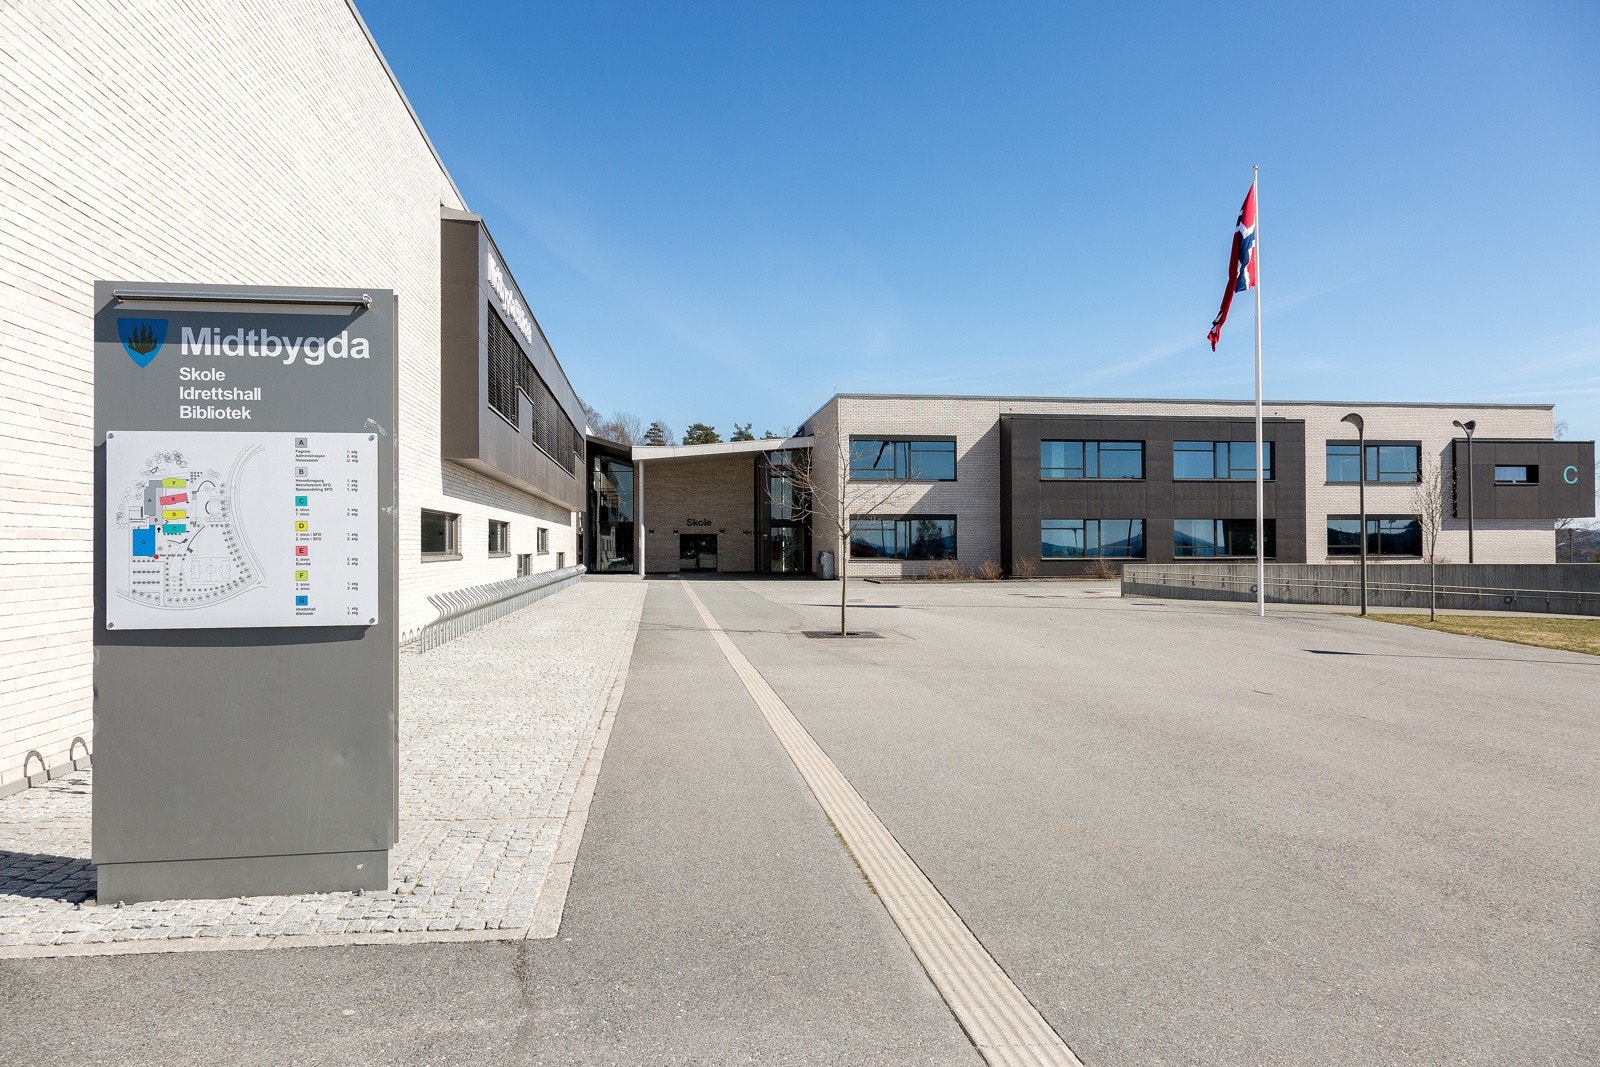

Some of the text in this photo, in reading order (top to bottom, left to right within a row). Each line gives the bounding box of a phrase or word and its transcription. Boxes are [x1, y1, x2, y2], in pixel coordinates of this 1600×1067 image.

[181, 326, 370, 366] Midtbygda
[179, 367, 226, 381] Skole
[179, 386, 262, 400] Idrettshall
[179, 405, 252, 420] Bibliotek
[1563, 465, 1578, 484] C
[686, 518, 712, 526] Skole
